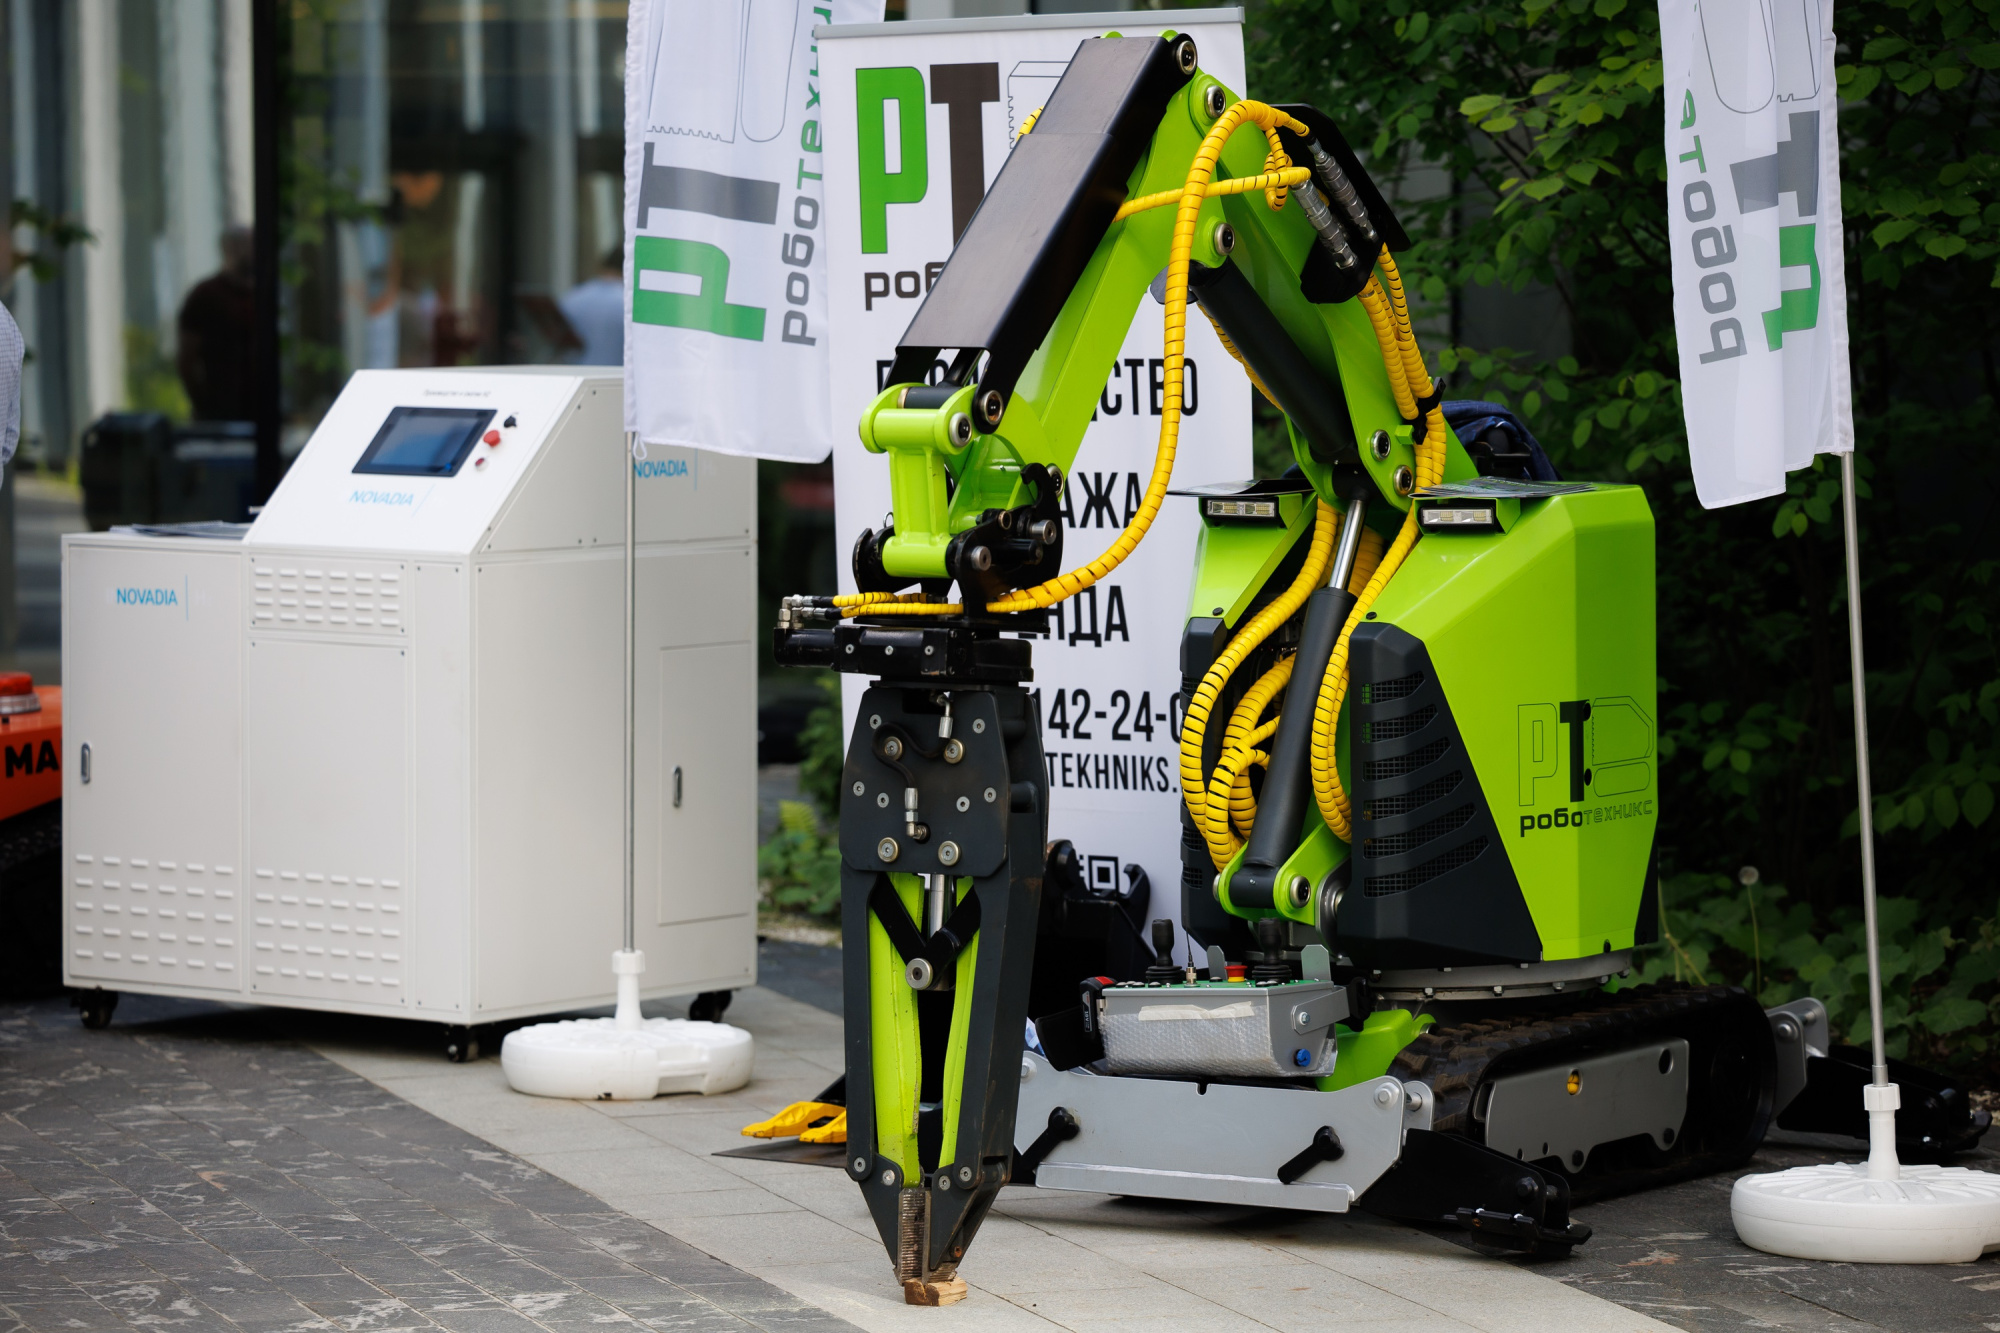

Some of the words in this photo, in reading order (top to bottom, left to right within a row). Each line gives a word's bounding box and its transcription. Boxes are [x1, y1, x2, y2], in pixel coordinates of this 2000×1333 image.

[634, 460, 688, 478] NOVADIA
[349, 490, 414, 506] NOVADIA
[116, 588, 178, 605] NOVADIA
